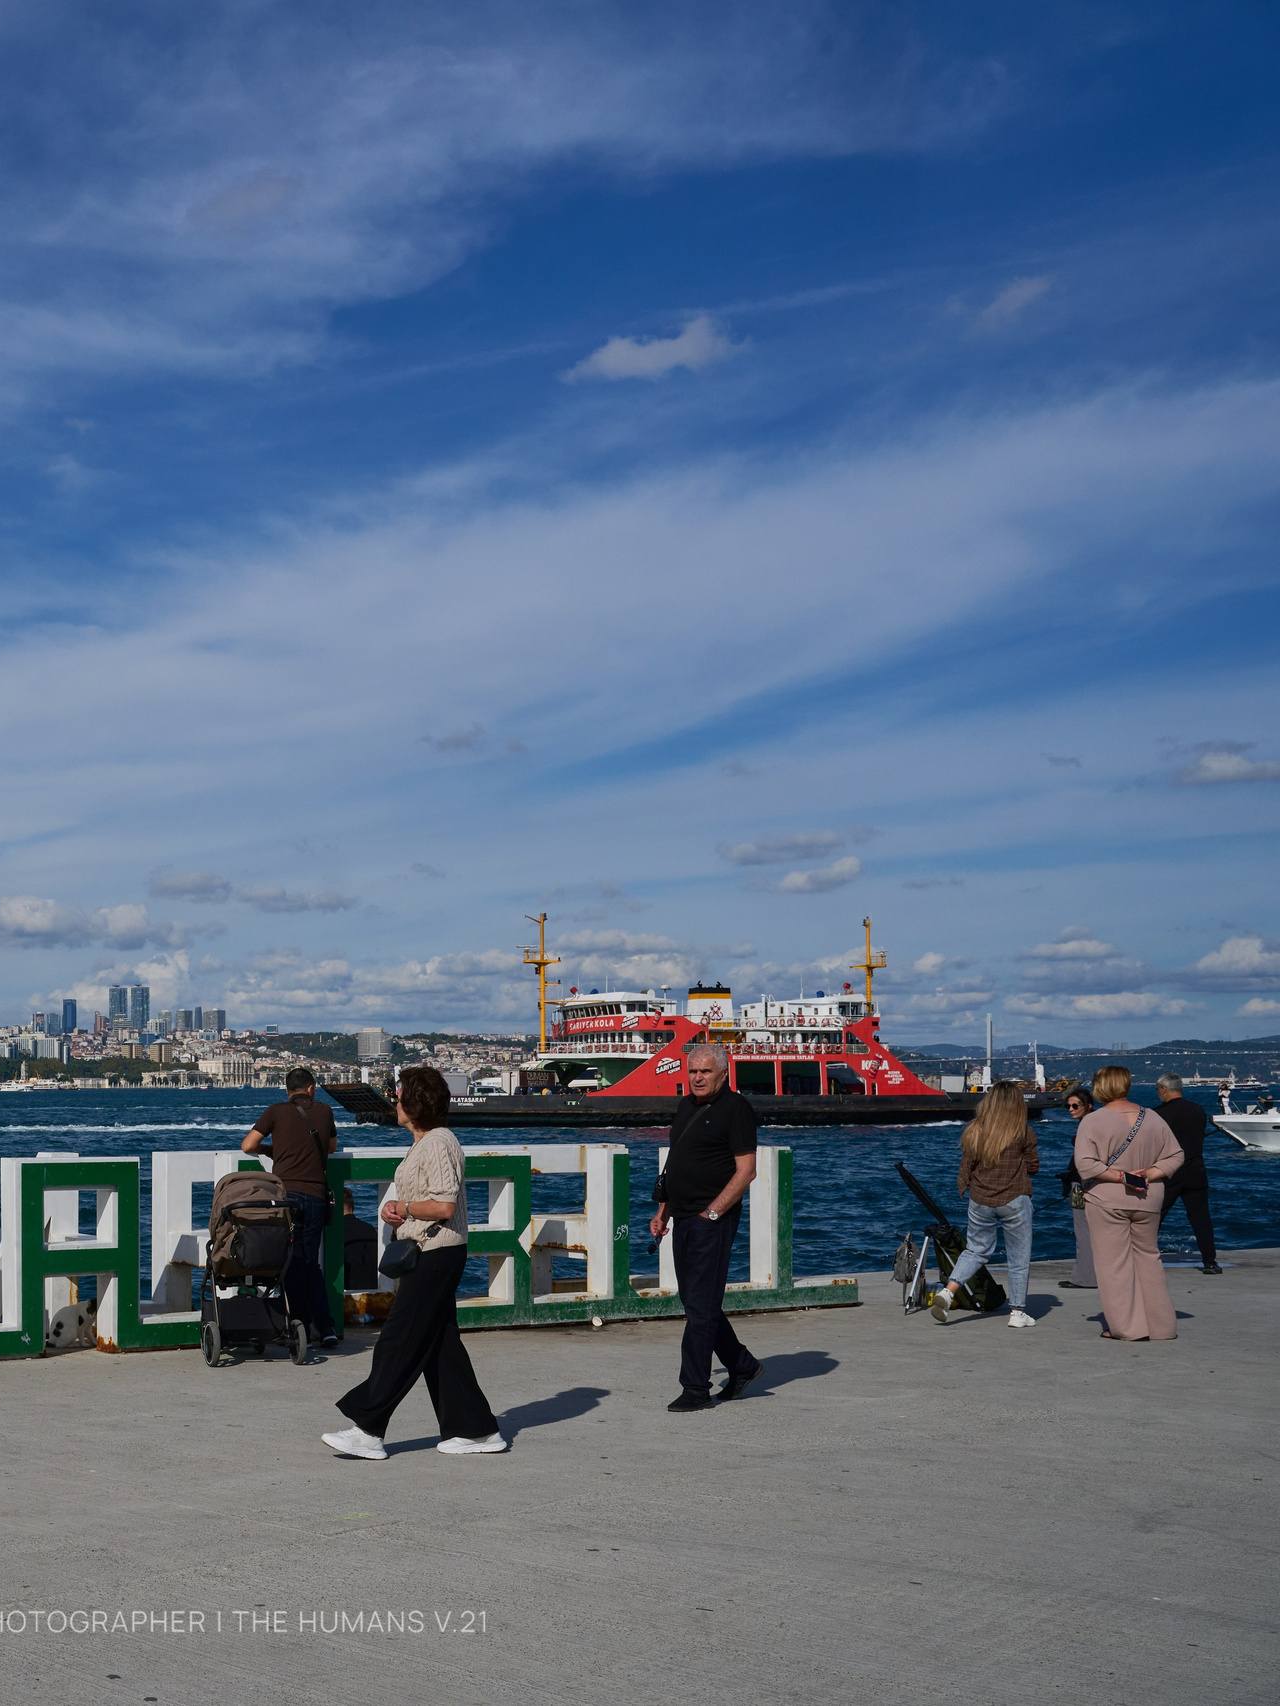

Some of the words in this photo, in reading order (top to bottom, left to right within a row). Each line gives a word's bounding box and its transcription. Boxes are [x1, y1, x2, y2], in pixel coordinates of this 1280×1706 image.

[569, 1020, 594, 1031] SARIYER
[594, 1018, 615, 1028] KOLA
[655, 1059, 681, 1075] SARIYER
